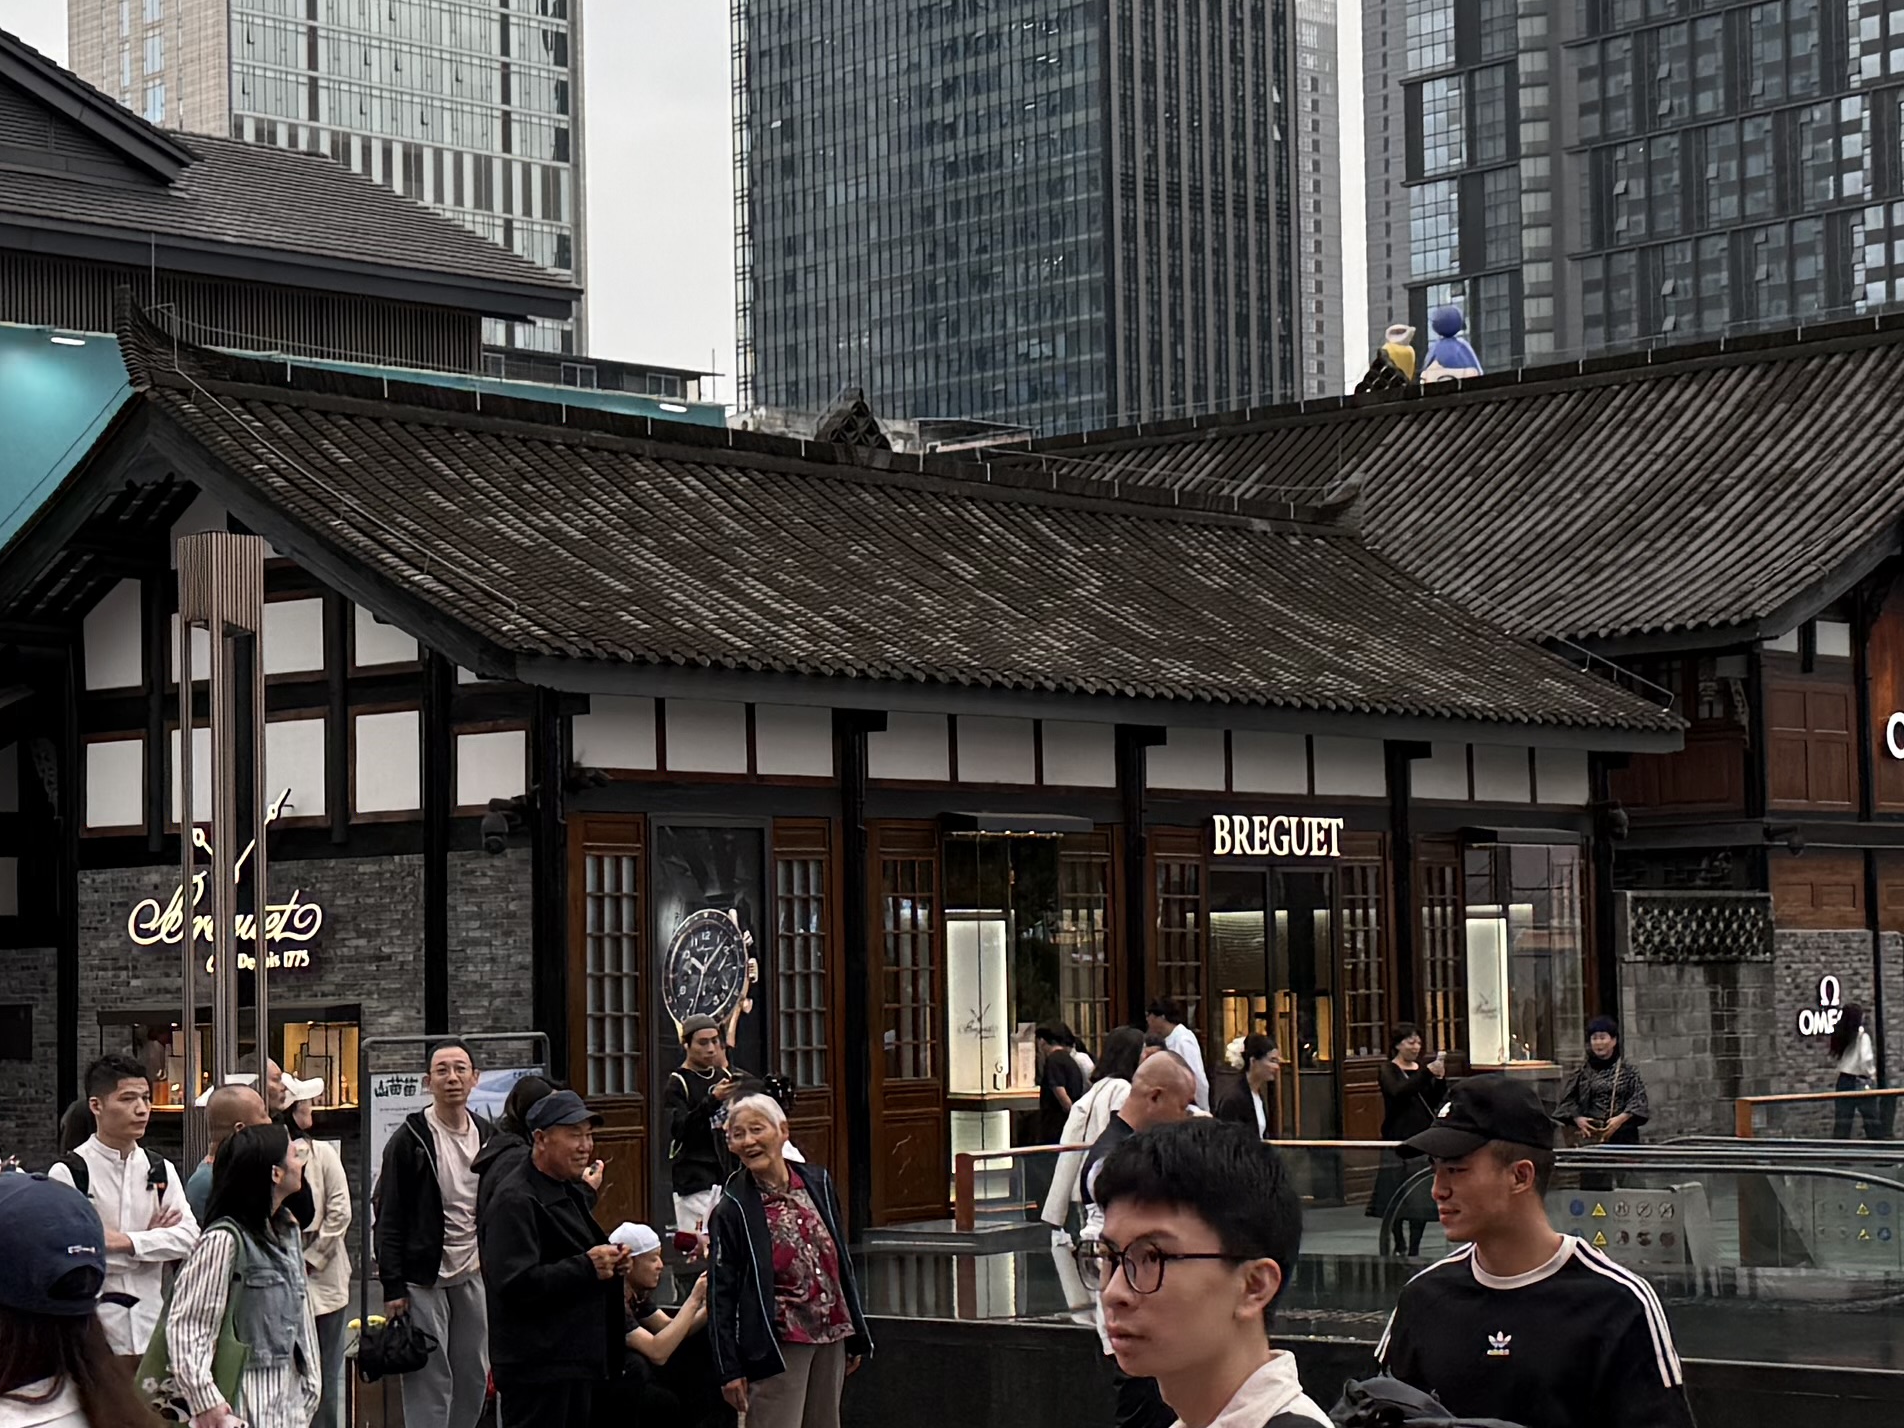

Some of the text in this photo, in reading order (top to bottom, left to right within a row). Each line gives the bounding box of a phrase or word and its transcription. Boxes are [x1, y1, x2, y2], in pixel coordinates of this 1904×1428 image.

[1212, 814, 1344, 857] BREGUET
[283, 949, 310, 969] 1775
[1798, 1008, 1843, 1036] OME
